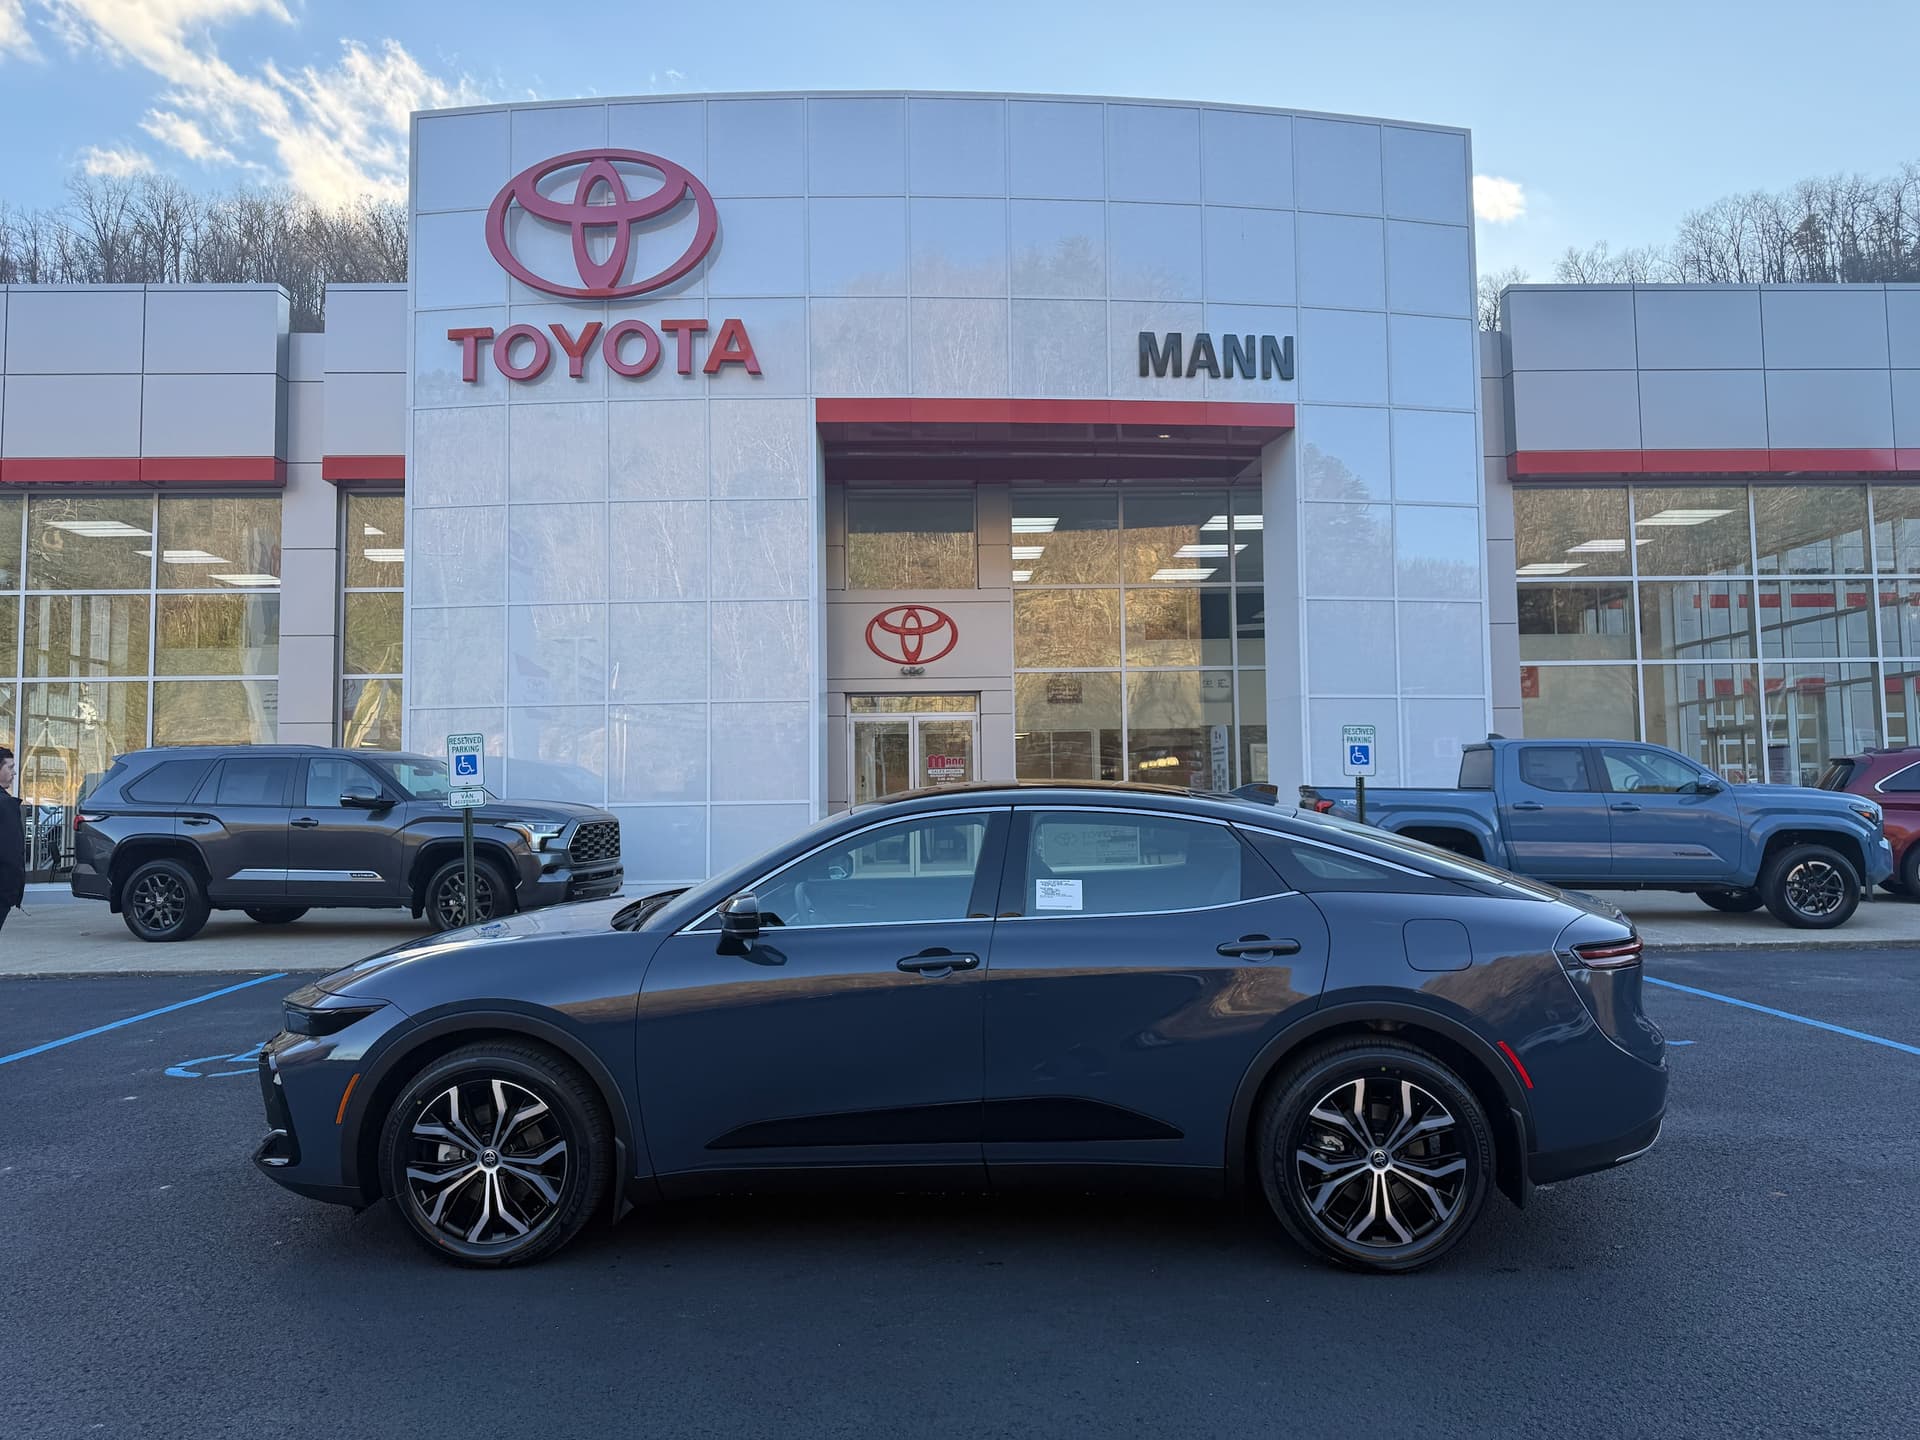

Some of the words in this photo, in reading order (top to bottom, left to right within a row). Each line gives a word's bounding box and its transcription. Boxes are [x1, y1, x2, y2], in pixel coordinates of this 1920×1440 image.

[447, 318, 763, 383] TOYOTA
[1139, 331, 1295, 380] MANN
[448, 736, 482, 745] RESERVED
[1346, 736, 1372, 744] PARKING
[451, 745, 480, 753] PARKING
